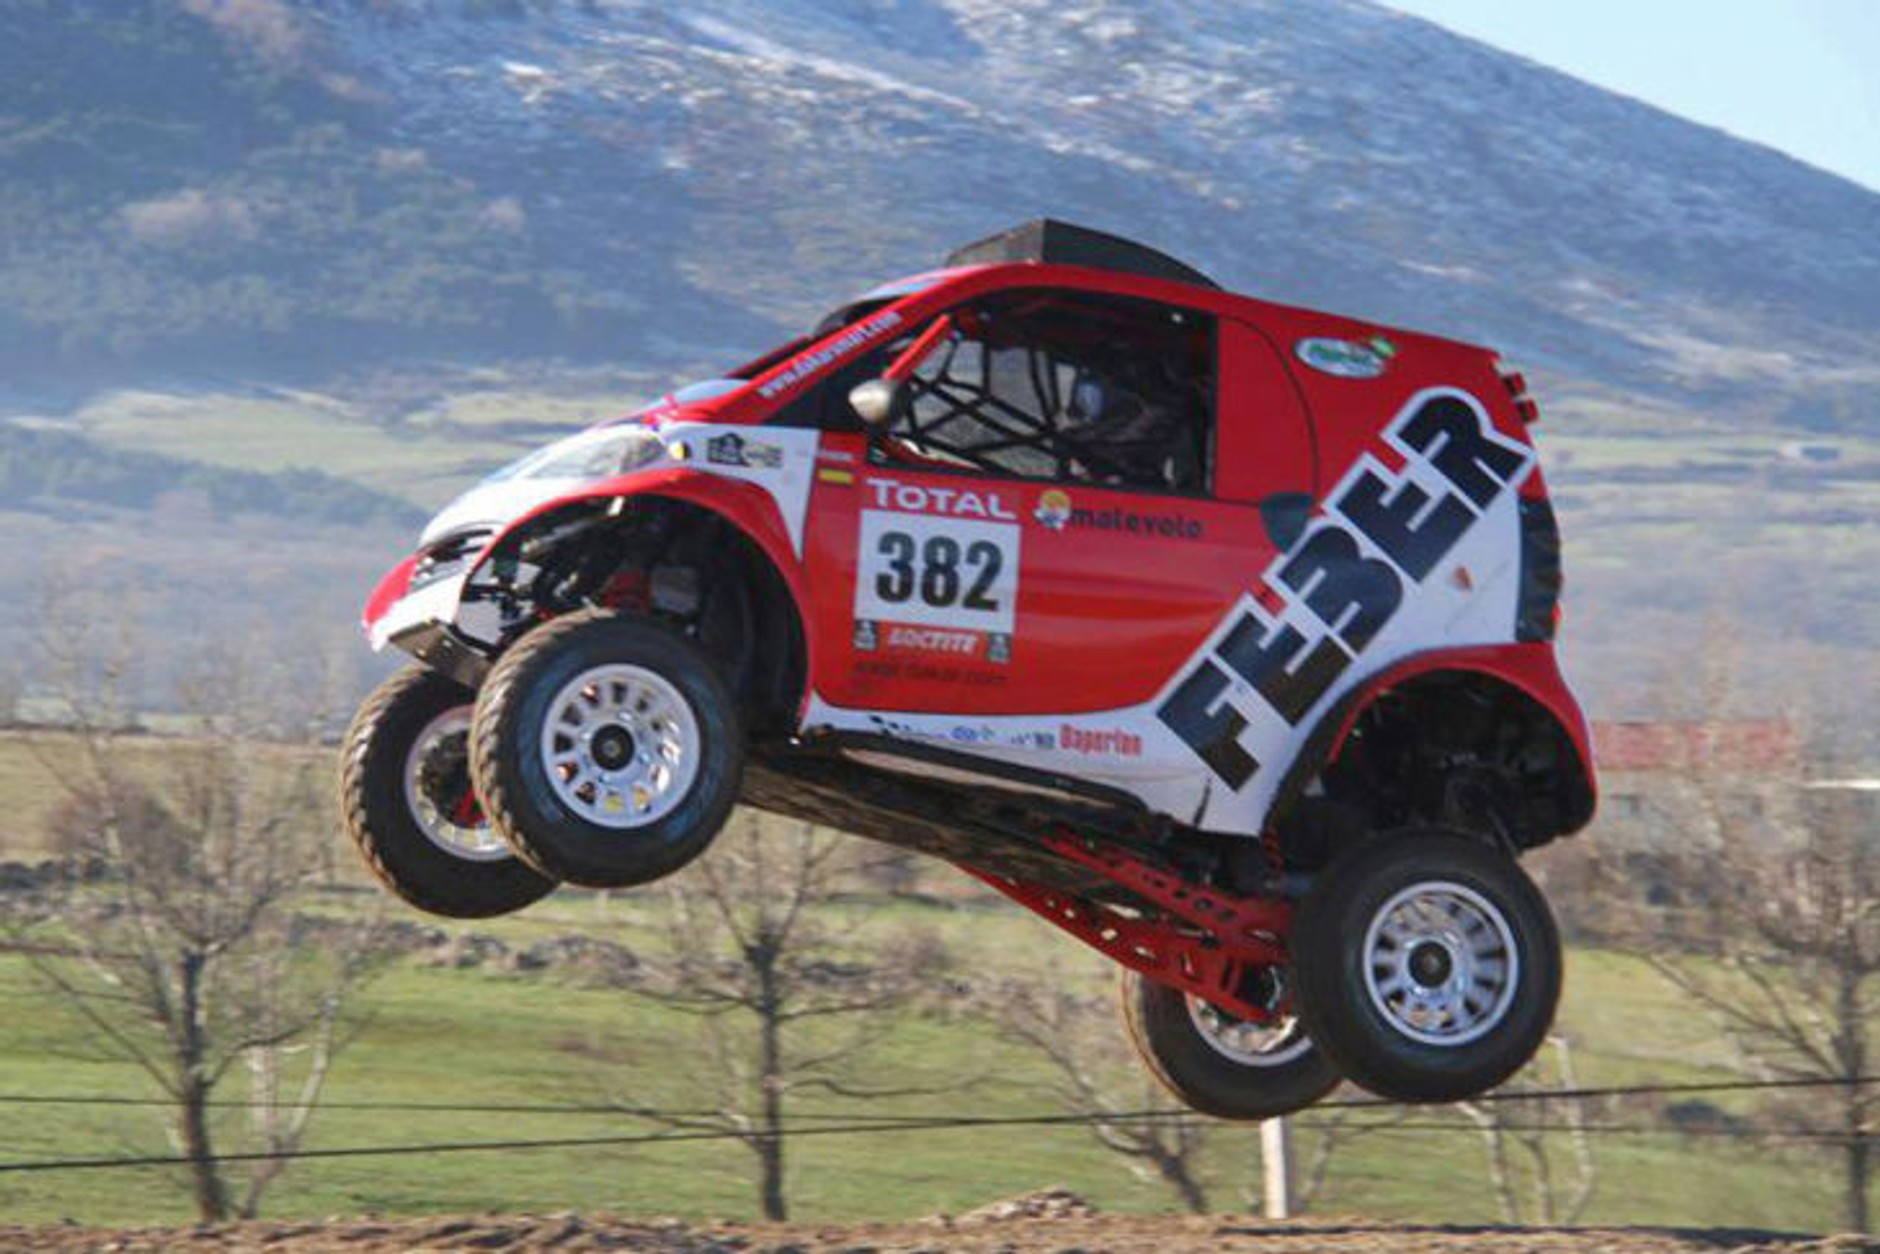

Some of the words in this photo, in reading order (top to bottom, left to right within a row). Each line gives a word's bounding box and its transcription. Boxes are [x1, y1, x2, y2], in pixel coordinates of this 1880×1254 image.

[866, 478, 1018, 521] TOTAL
[875, 531, 1005, 613] 382
[1156, 394, 1530, 794] FEBER
